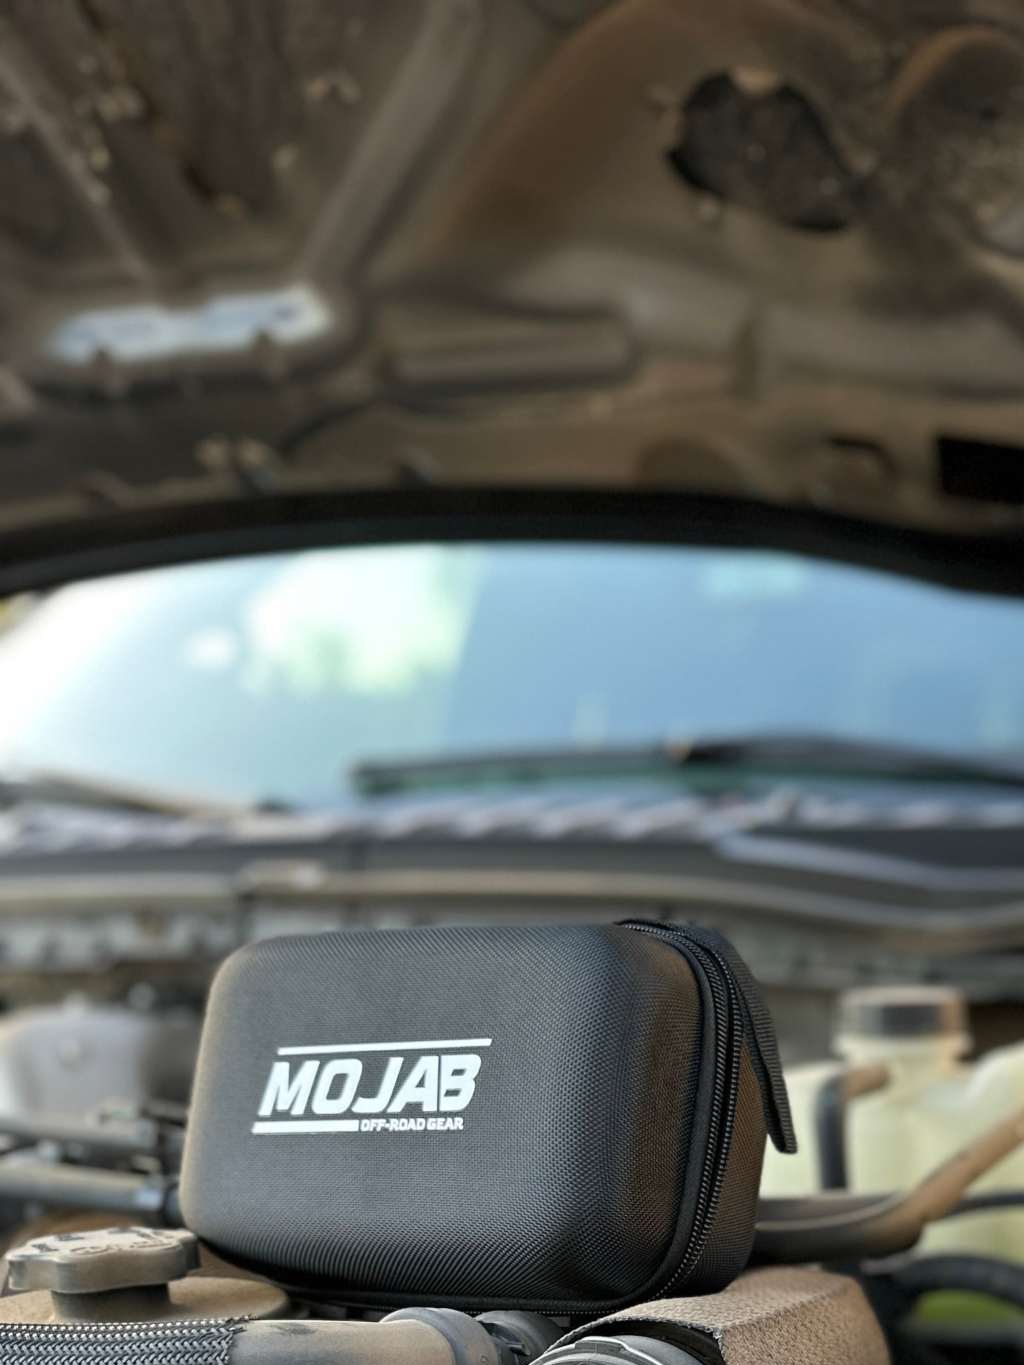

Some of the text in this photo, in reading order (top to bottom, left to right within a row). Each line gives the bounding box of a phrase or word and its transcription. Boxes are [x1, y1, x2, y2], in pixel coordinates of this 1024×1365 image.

[257, 1053, 482, 1117] MOJAB
[360, 1117, 464, 1132] OFF-ROAD GEAR
